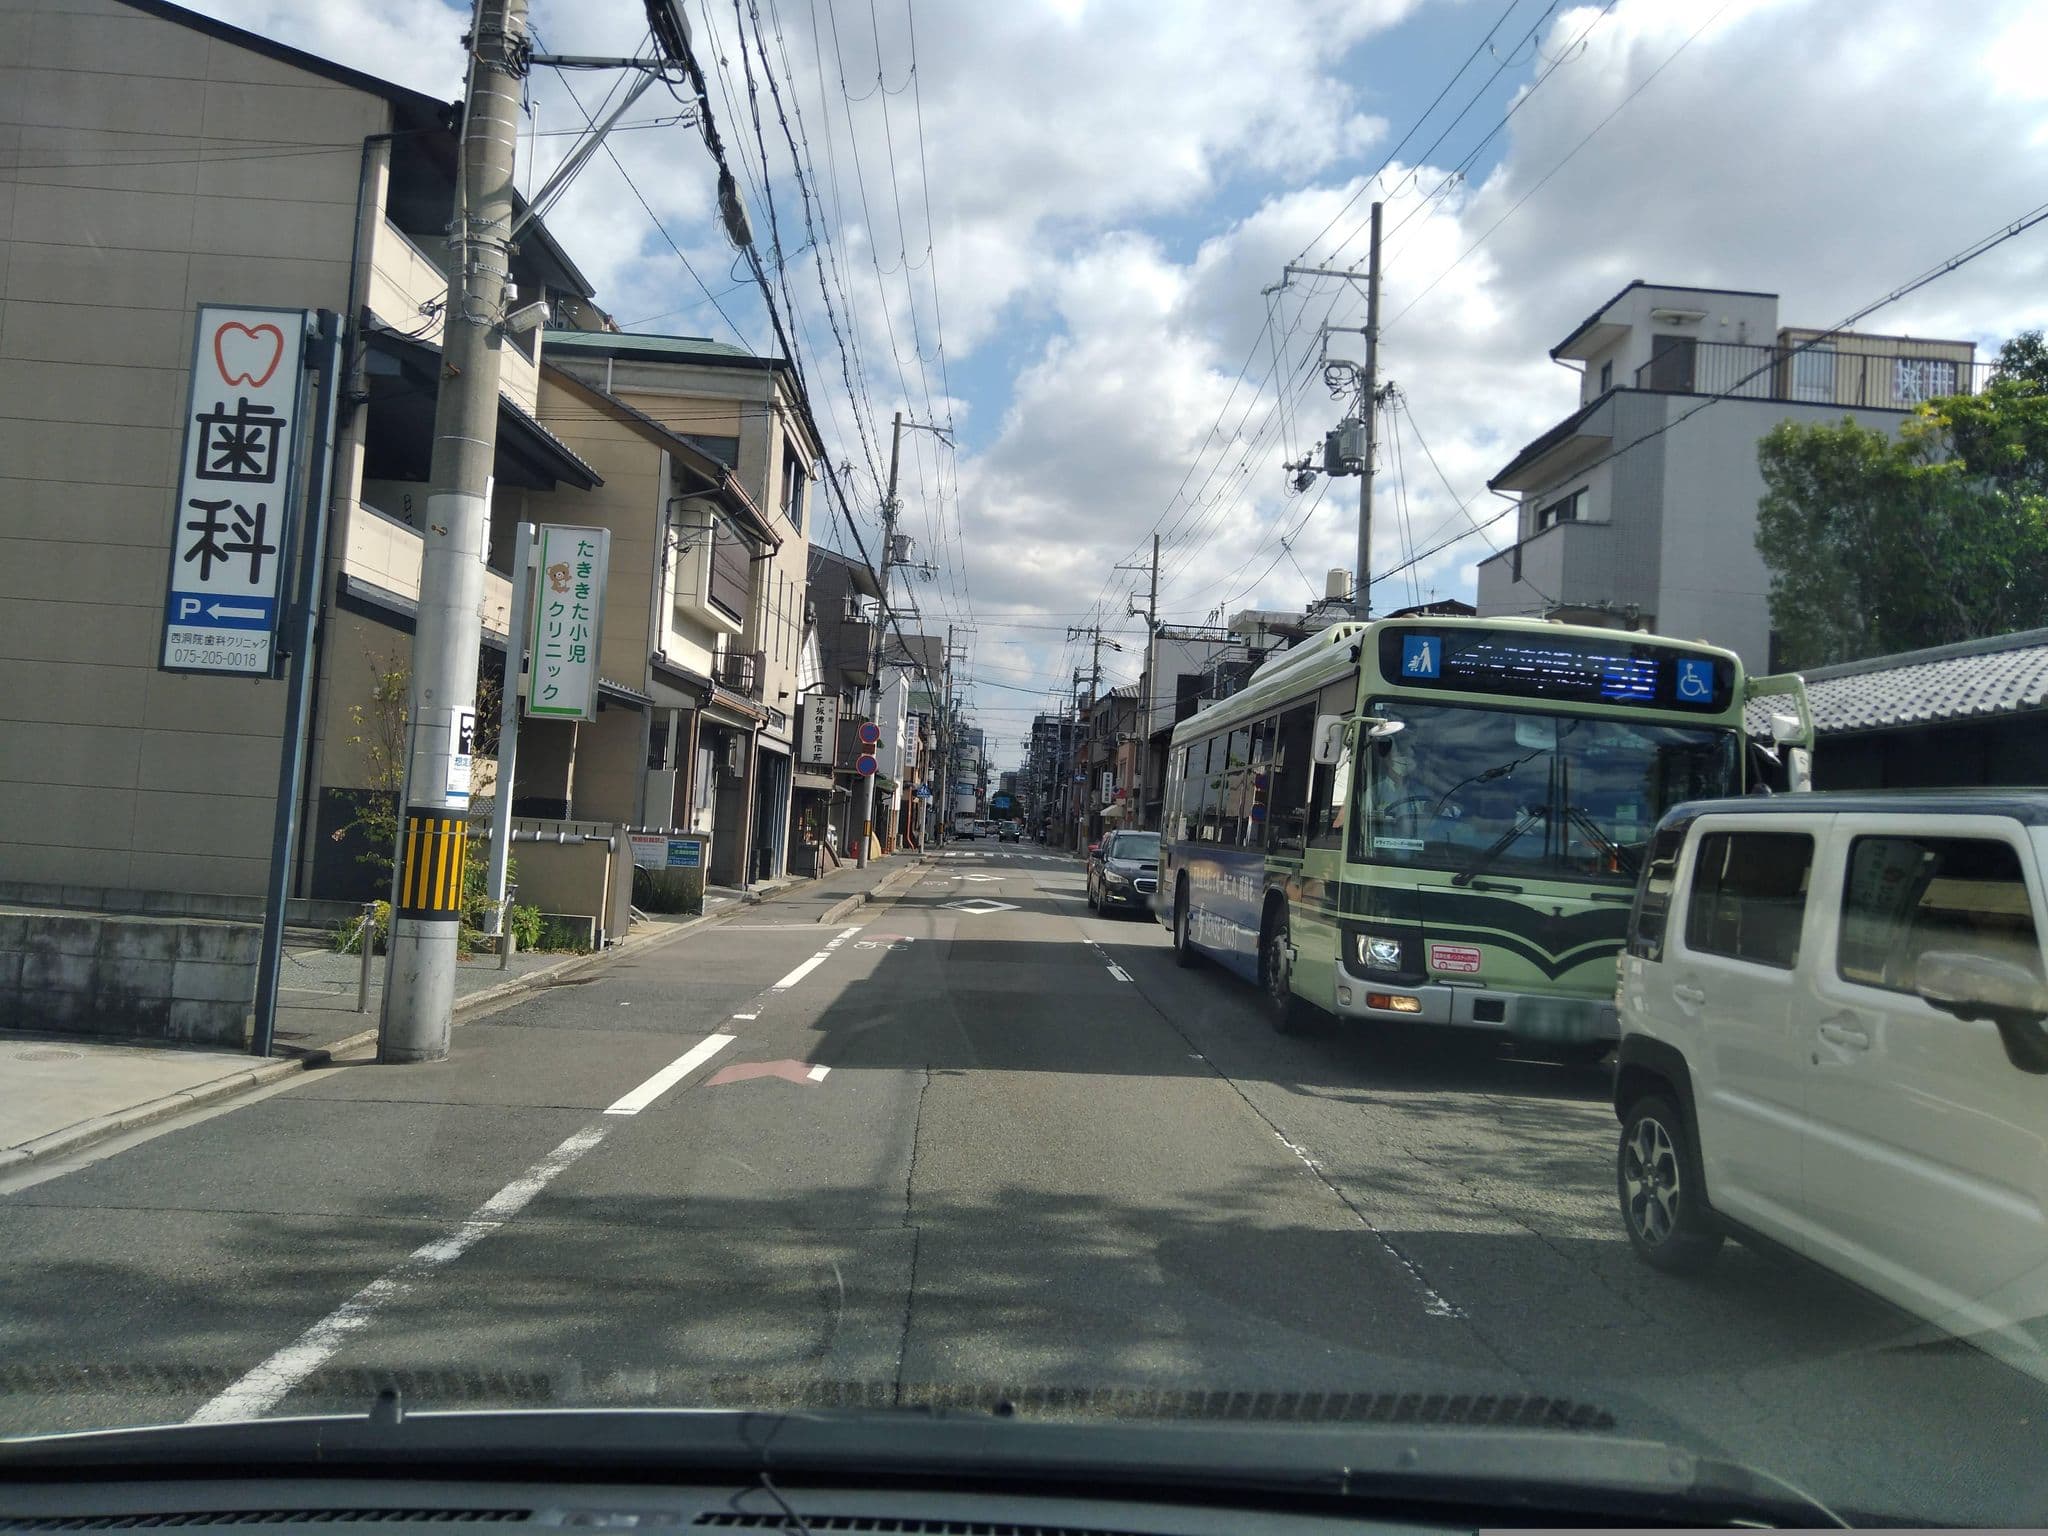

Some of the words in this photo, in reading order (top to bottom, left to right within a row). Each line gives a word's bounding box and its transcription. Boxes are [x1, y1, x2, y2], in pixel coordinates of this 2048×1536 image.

[184, 397, 287, 584] 歯科
[179, 598, 201, 620] P
[567, 540, 594, 663] たききた小児
[171, 632, 268, 649] 西洞院歯科クリニック
[175, 649, 257, 667] 075-205-0018
[543, 601, 565, 700] クリニック
